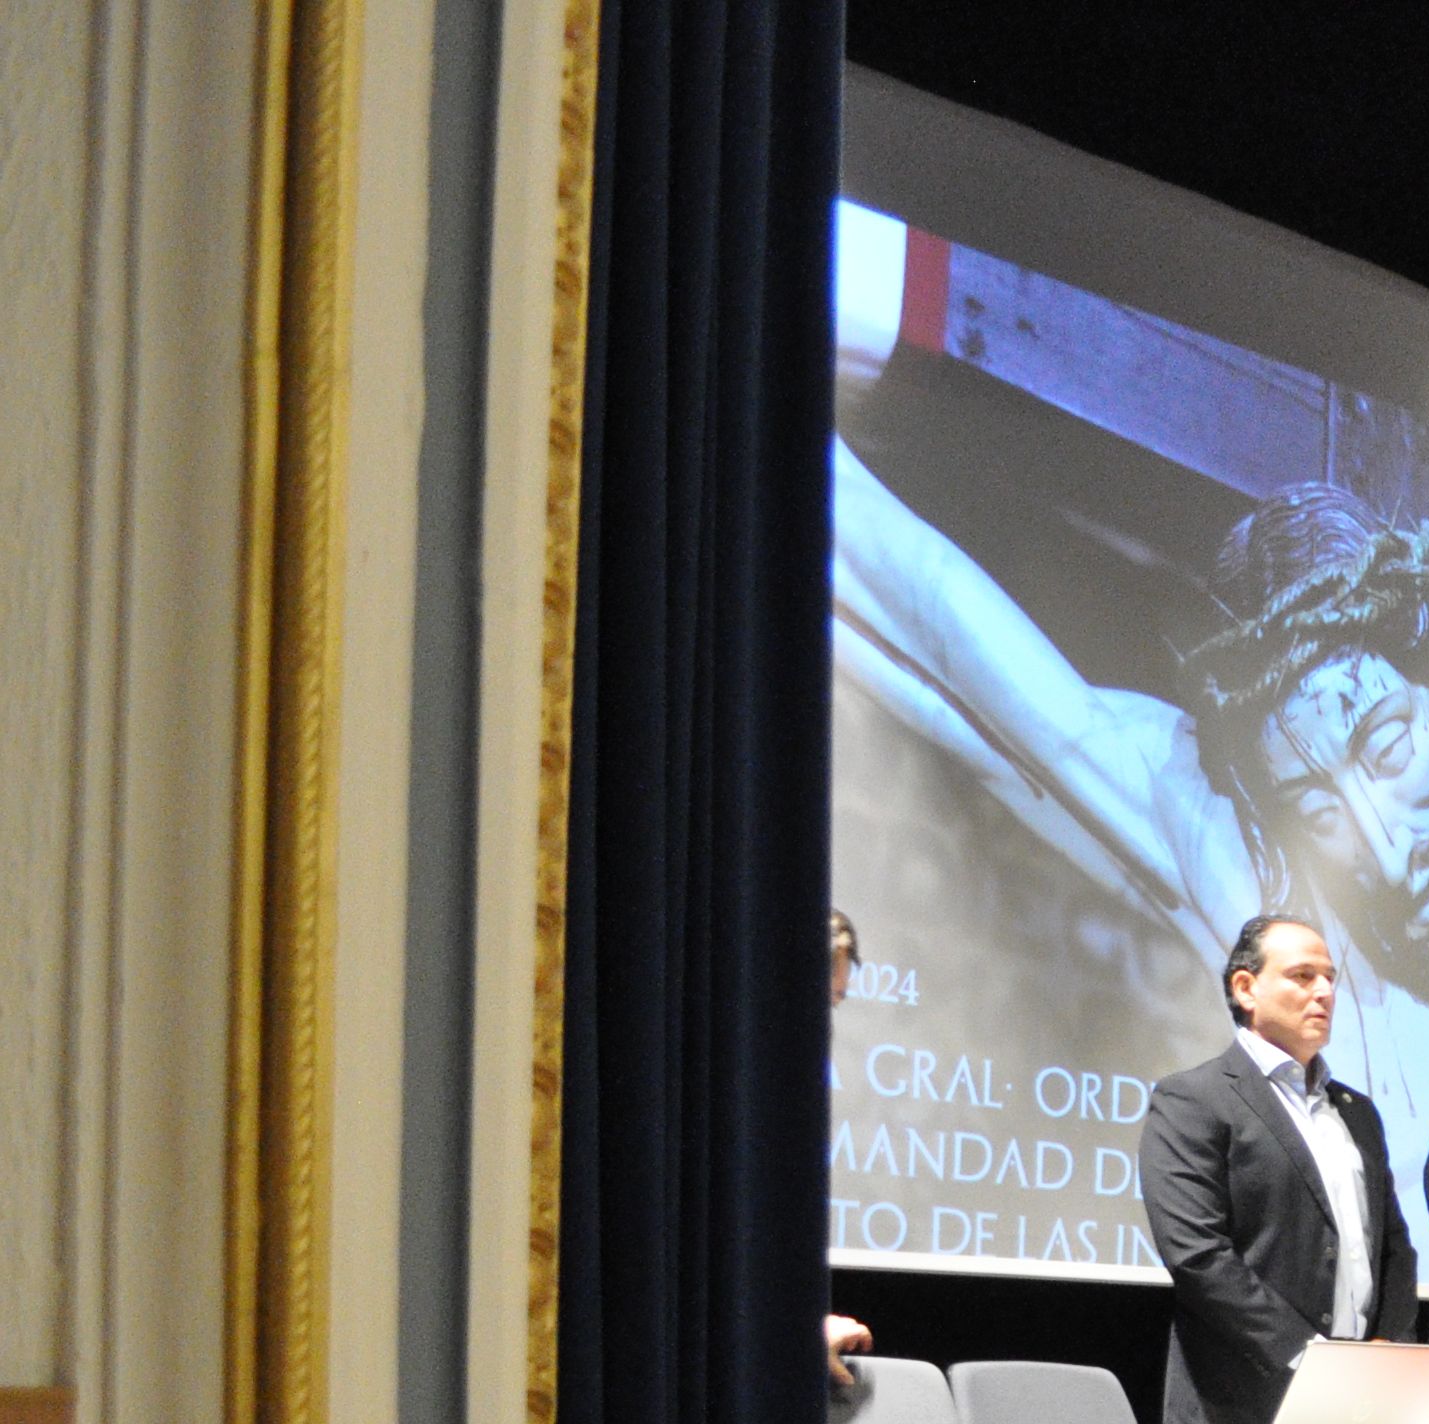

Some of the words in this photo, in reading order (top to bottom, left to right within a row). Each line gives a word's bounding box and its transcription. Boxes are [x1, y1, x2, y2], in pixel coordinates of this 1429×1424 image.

[846, 961, 919, 1006] 2024
[1035, 1066, 1155, 1124] ORD
[1018, 1215, 1098, 1264] LAS
